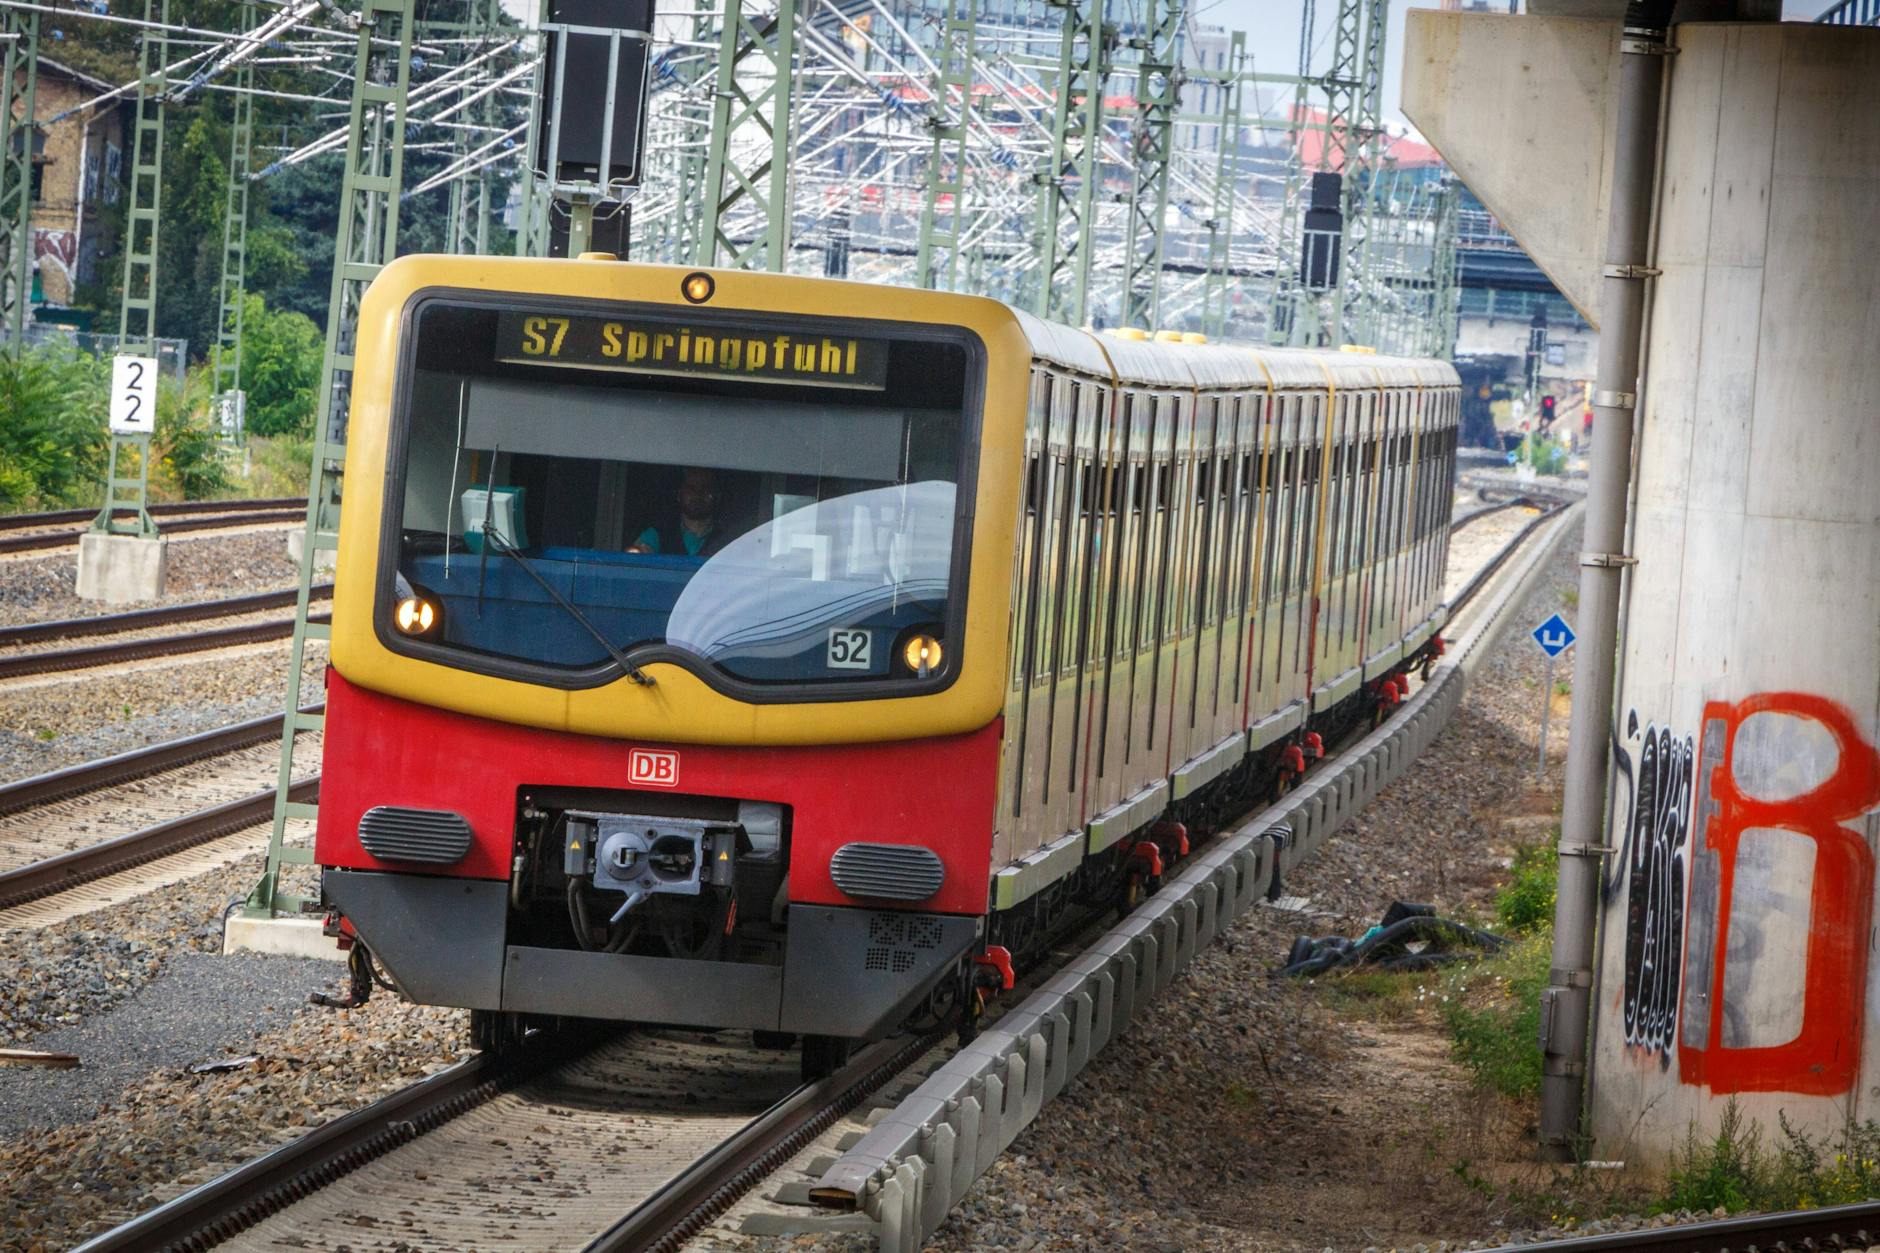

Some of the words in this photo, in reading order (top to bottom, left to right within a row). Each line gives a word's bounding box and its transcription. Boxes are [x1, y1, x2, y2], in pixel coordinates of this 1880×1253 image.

[522, 316, 570, 357] S7
[601, 322, 857, 375] Springpfuhl
[127, 361, 144, 390] 2
[124, 394, 142, 422] 2
[831, 631, 869, 663] 52
[633, 753, 674, 781] DB
